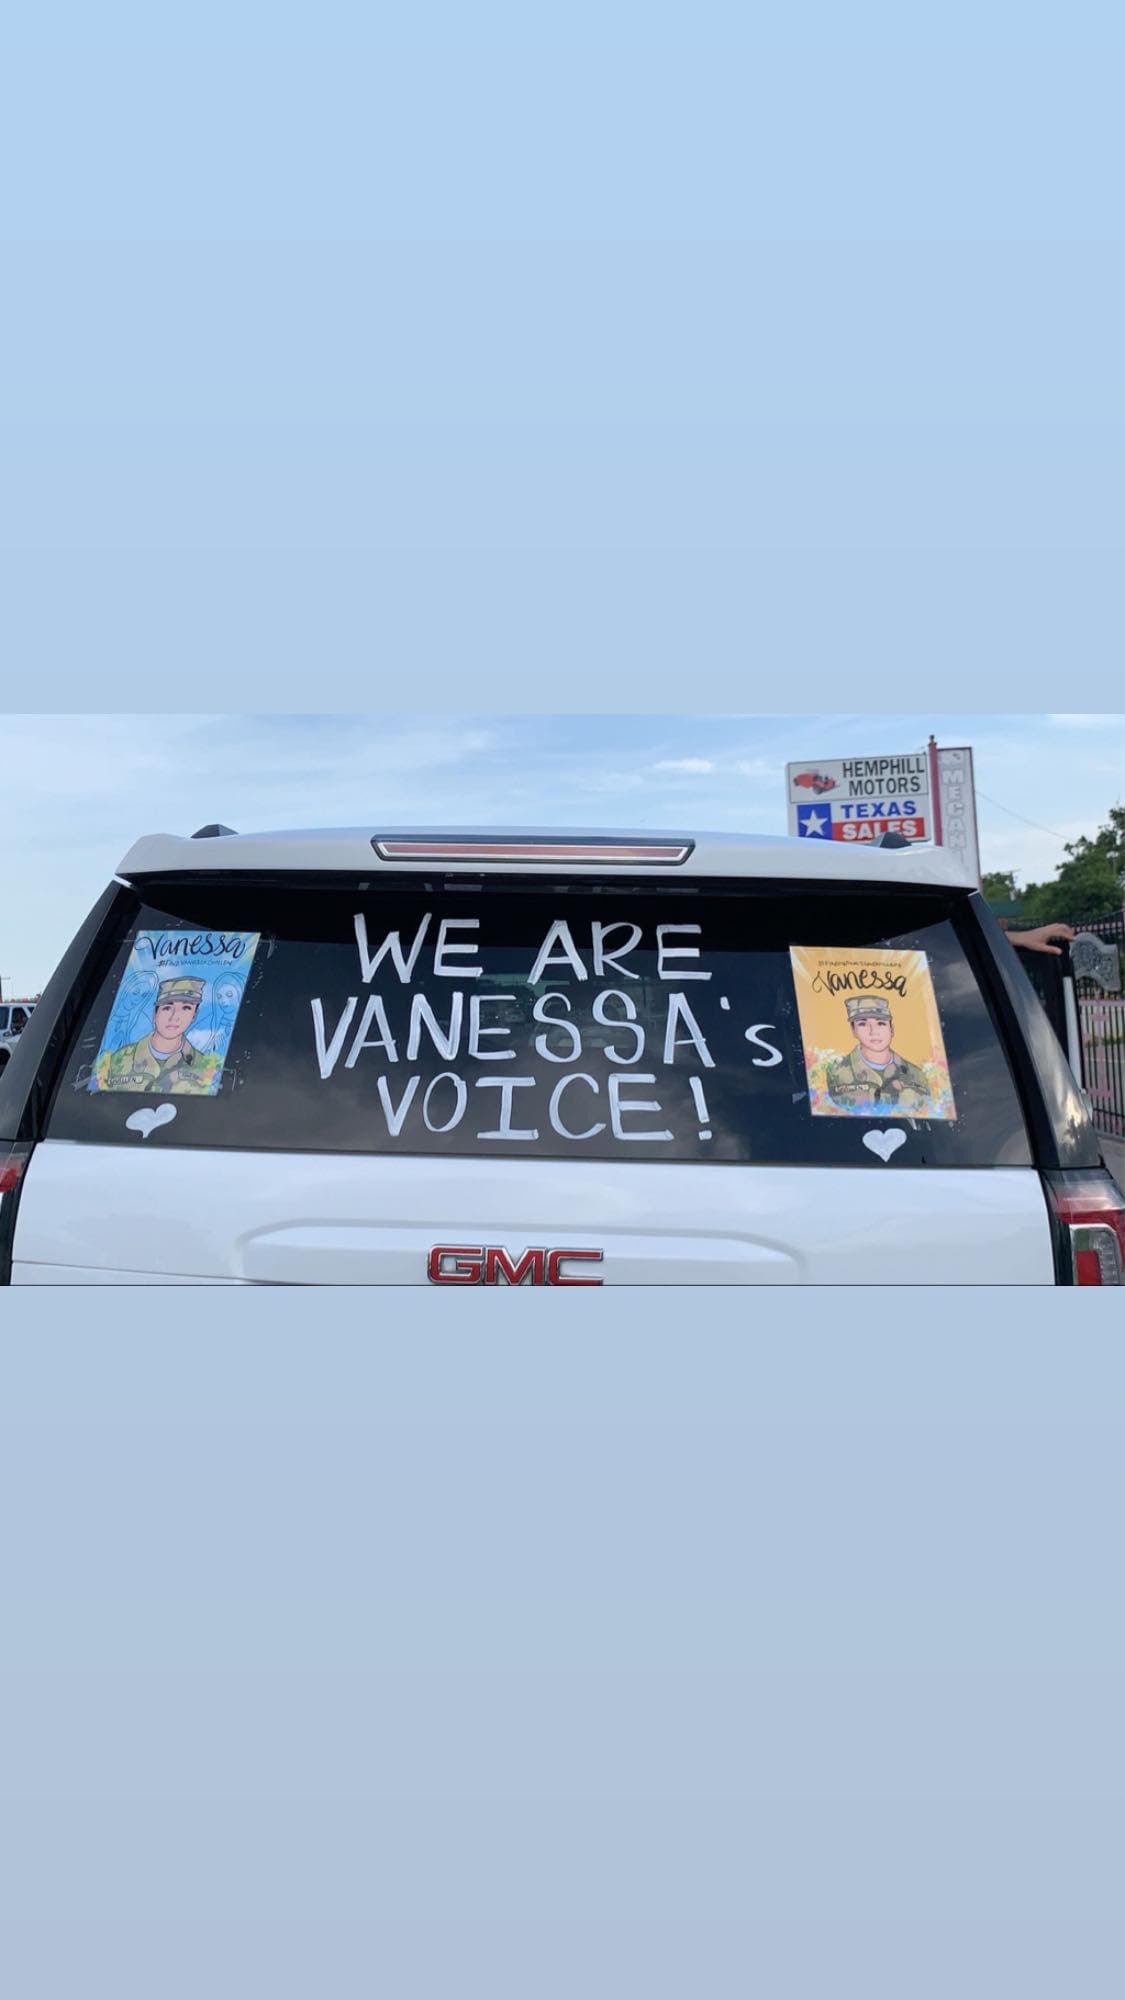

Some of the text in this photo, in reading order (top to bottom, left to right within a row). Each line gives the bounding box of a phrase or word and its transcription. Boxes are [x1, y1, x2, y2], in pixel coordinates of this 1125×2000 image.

[842, 757, 925, 779] HEMPHILL
[849, 776, 921, 797] MOTORS
[840, 800, 917, 819] TEXAS
[353, 912, 713, 986] WE ARE
[812, 969, 908, 998] Vanessa
[376, 1072, 713, 1141] VOICE!
[427, 1243, 604, 1286] GMC
